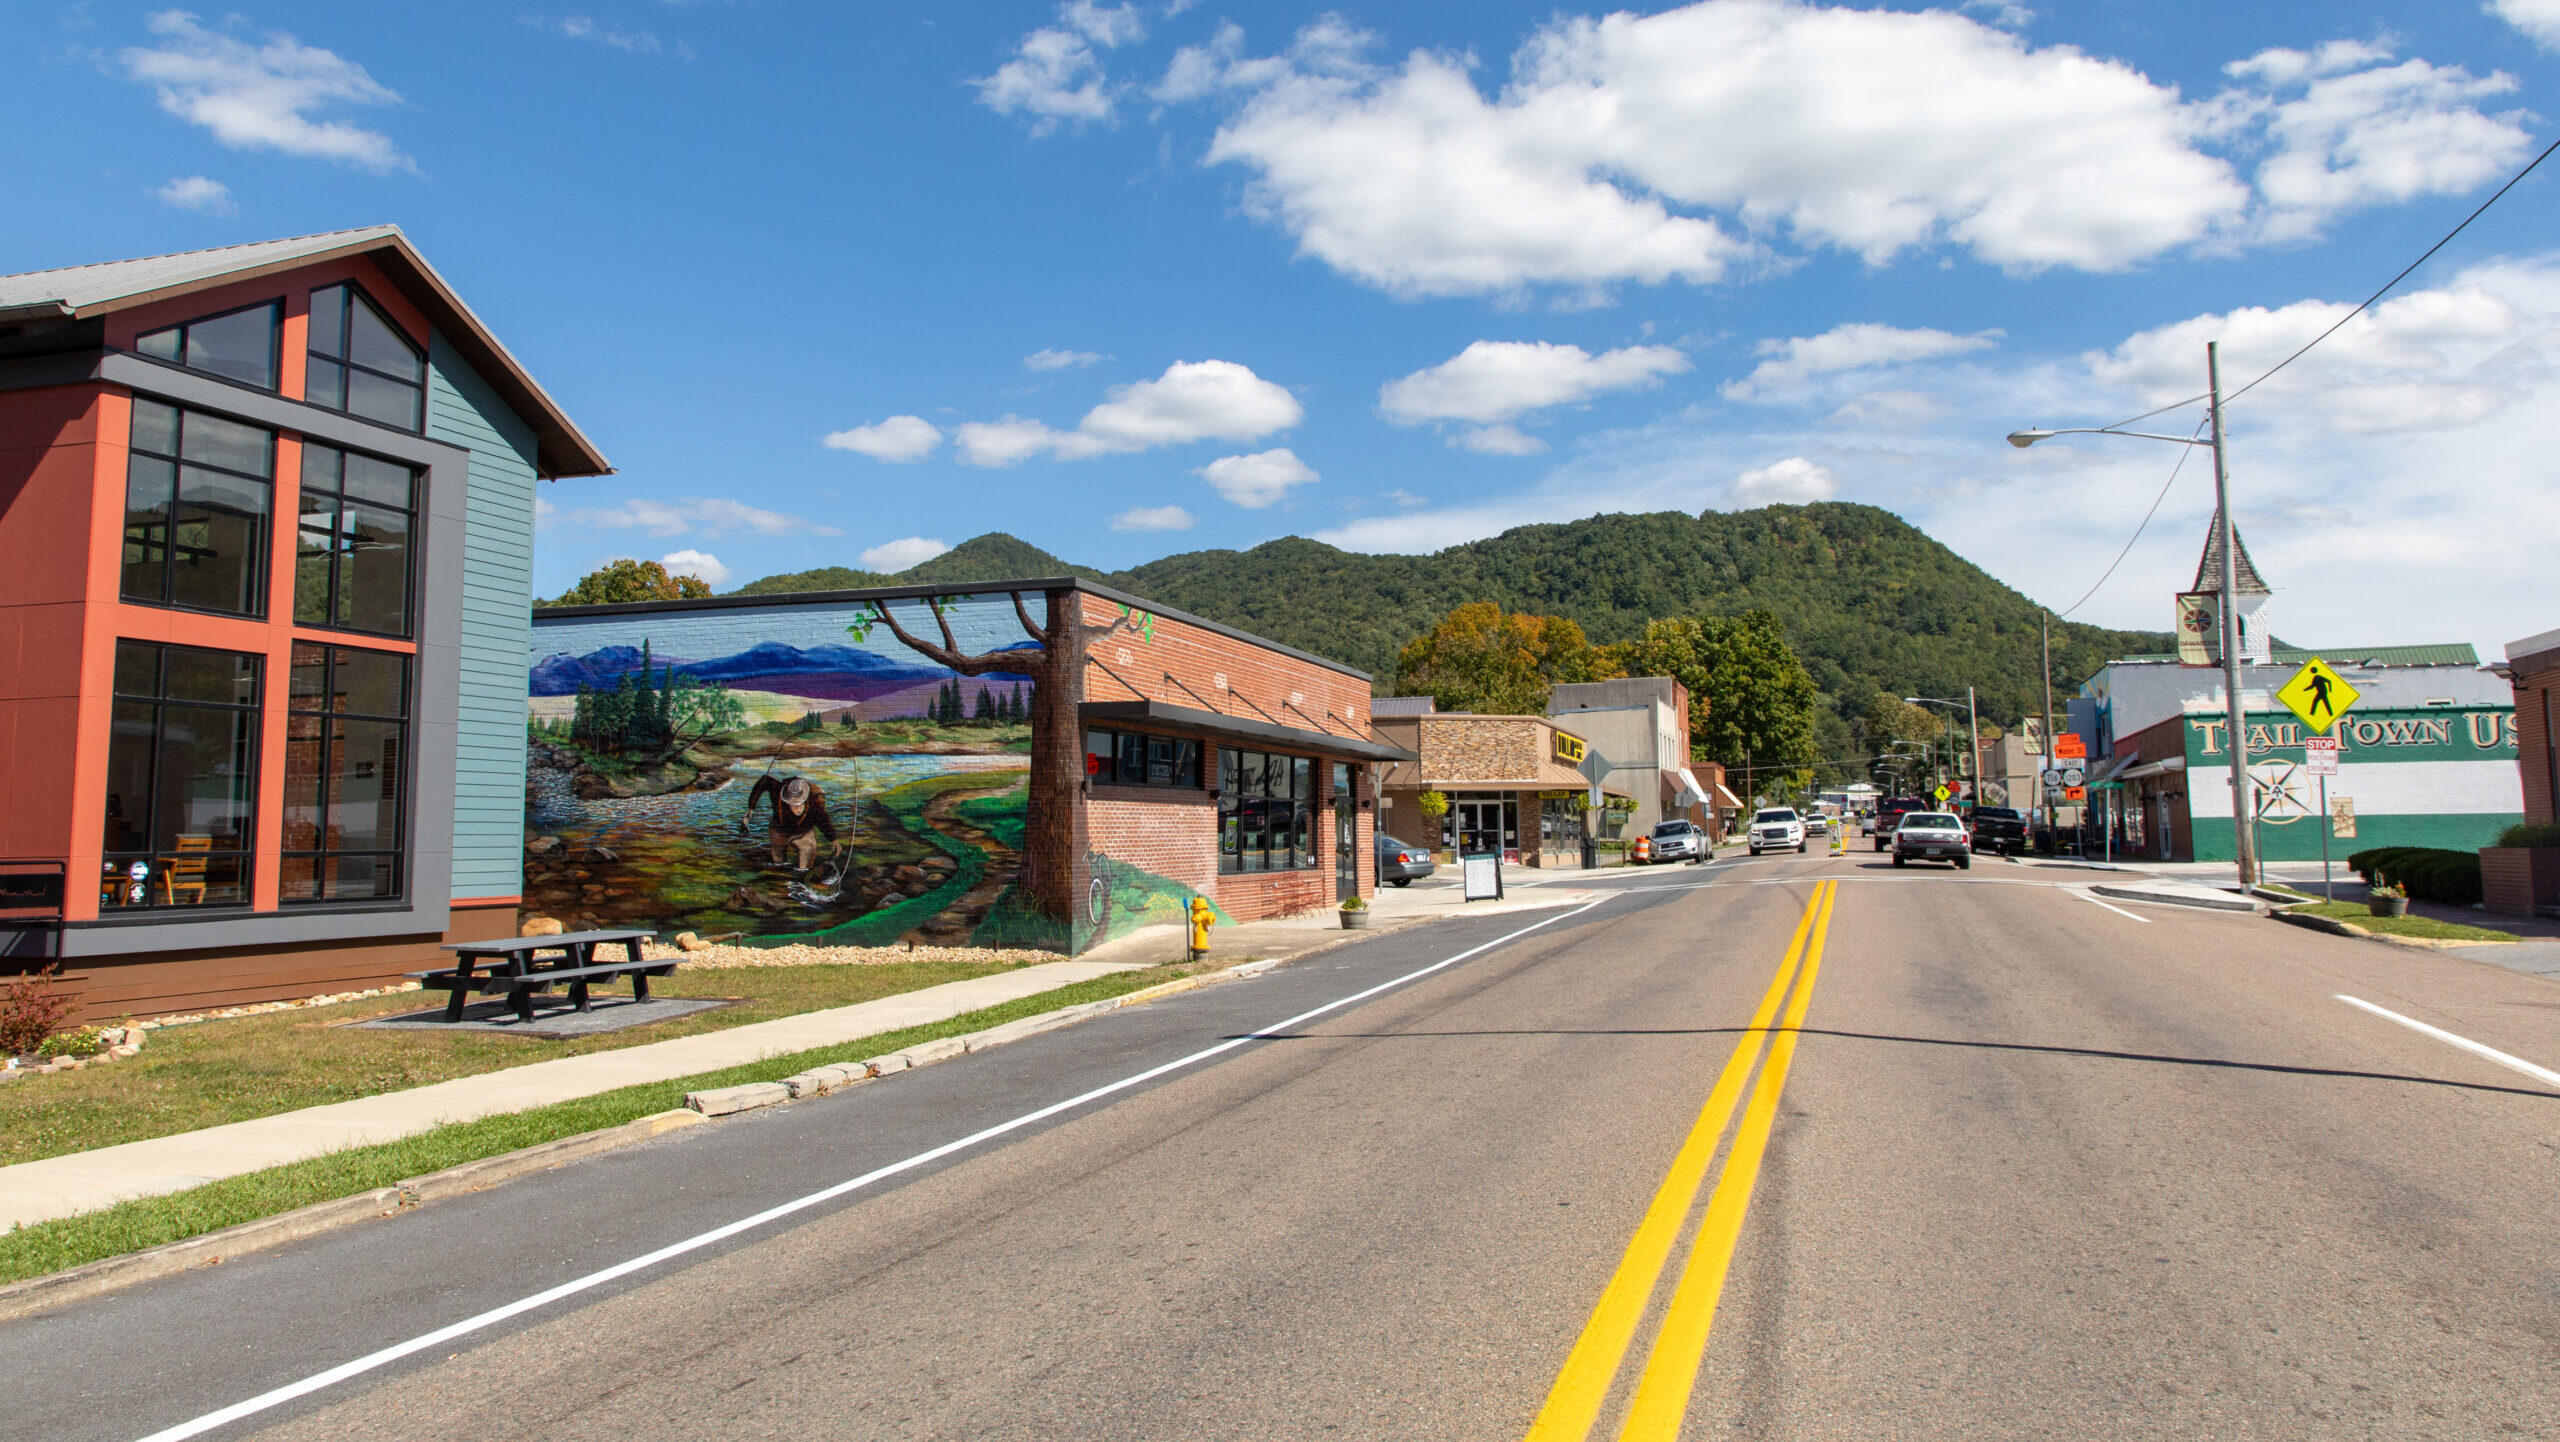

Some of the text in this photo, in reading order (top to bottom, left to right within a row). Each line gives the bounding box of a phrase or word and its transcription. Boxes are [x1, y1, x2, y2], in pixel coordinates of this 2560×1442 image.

[2307, 740, 2335, 749] STOP
[2047, 773, 2058, 781] 716
[2065, 773, 2081, 782] 1203
